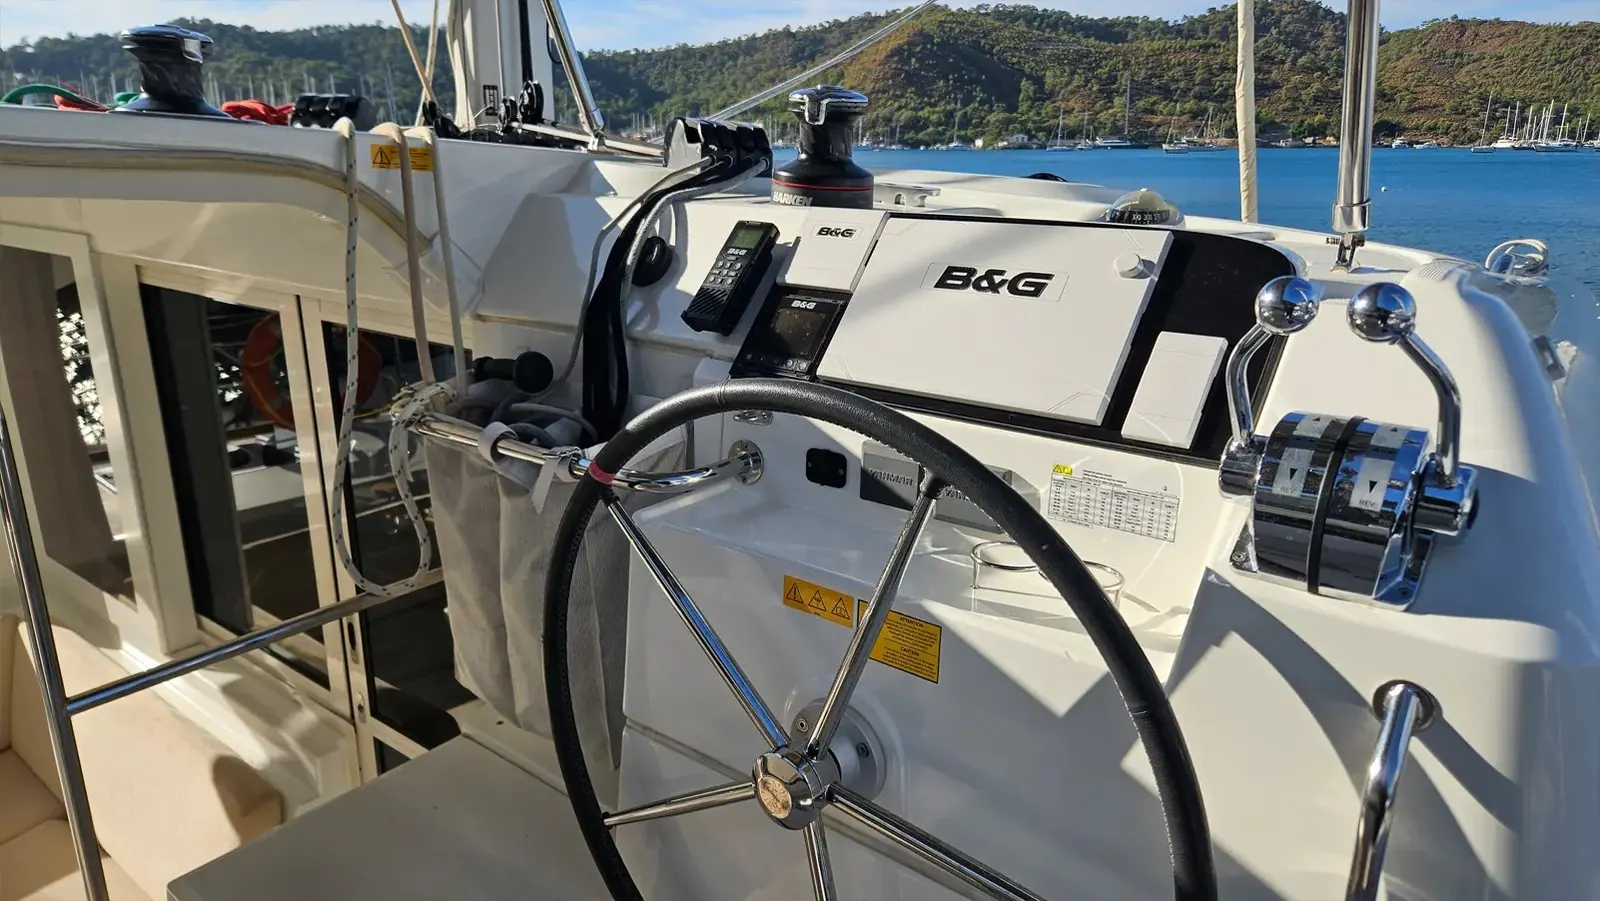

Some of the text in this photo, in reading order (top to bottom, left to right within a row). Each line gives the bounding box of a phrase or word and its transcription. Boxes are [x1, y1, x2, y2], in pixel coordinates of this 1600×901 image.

[773, 191, 813, 206] HARKEN
[816, 227, 856, 238] B&G
[727, 248, 747, 256] B&G
[933, 265, 1055, 298] B&G
[791, 300, 817, 310] B&G
[869, 469, 913, 486] YANMAR
[1280, 486, 1297, 494] REV
[1358, 499, 1376, 508] REV
[899, 616, 924, 628] ATTENTION
[900, 646, 920, 657] CAUTION
